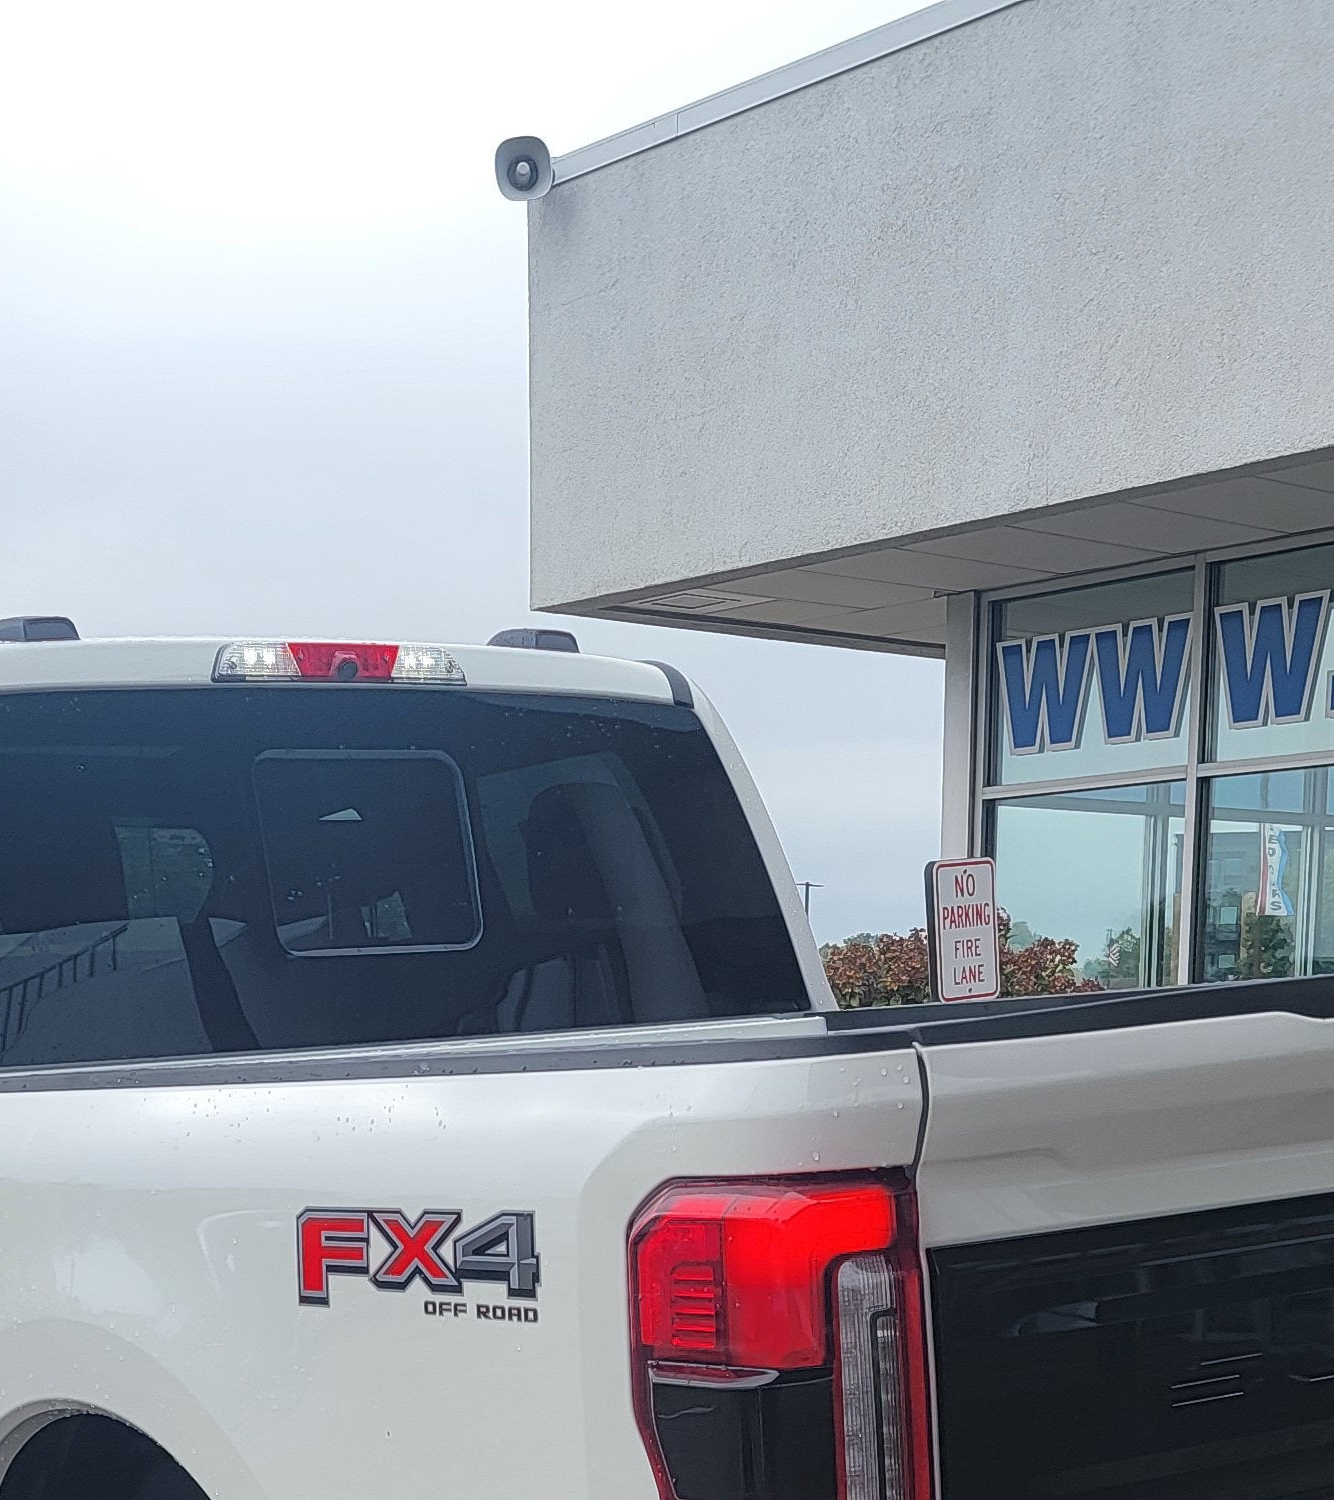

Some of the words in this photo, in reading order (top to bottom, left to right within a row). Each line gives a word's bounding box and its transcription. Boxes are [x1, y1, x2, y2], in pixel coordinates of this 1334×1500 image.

[954, 873, 976, 899] NO
[942, 902, 991, 931] PARKING
[953, 938, 982, 960] FIRE
[953, 963, 985, 986] LANE
[296, 1206, 542, 1308] FX4
[423, 1300, 468, 1318] OFF
[476, 1303, 539, 1323] ROAD
